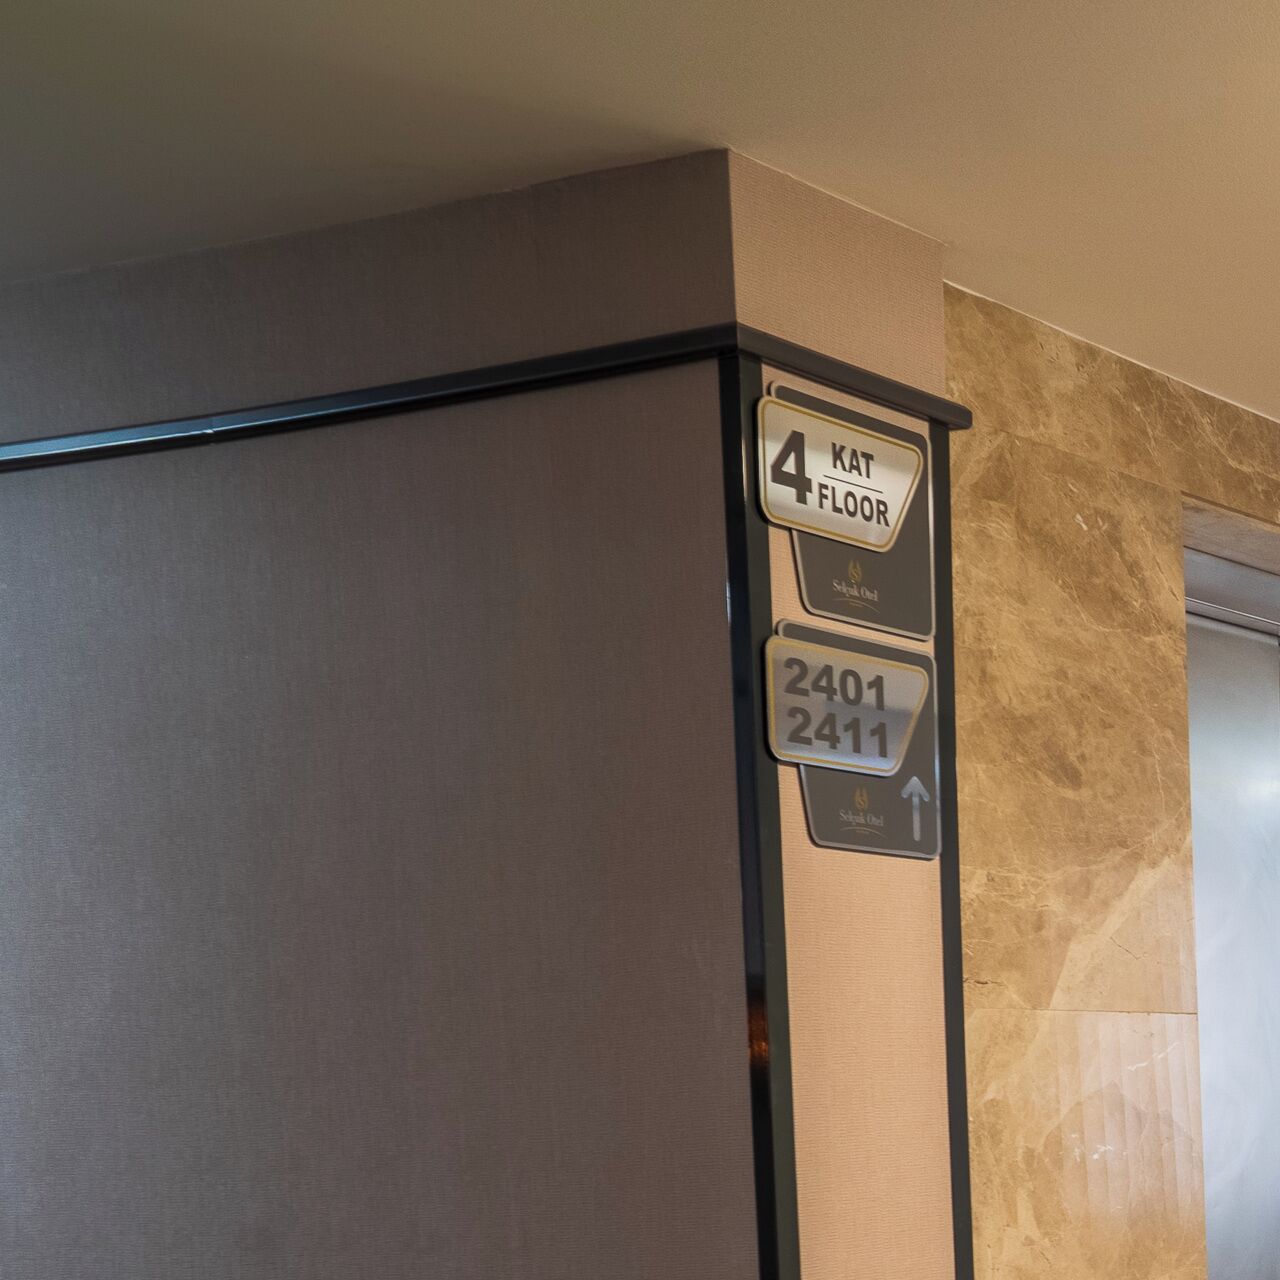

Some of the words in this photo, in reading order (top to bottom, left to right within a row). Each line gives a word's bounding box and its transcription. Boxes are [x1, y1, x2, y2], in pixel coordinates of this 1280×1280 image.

[770, 430, 812, 505] 4
[831, 441, 874, 480] KAT
[817, 481, 890, 528] FLOOR
[783, 657, 886, 711] 2401
[786, 706, 888, 758] 2411
